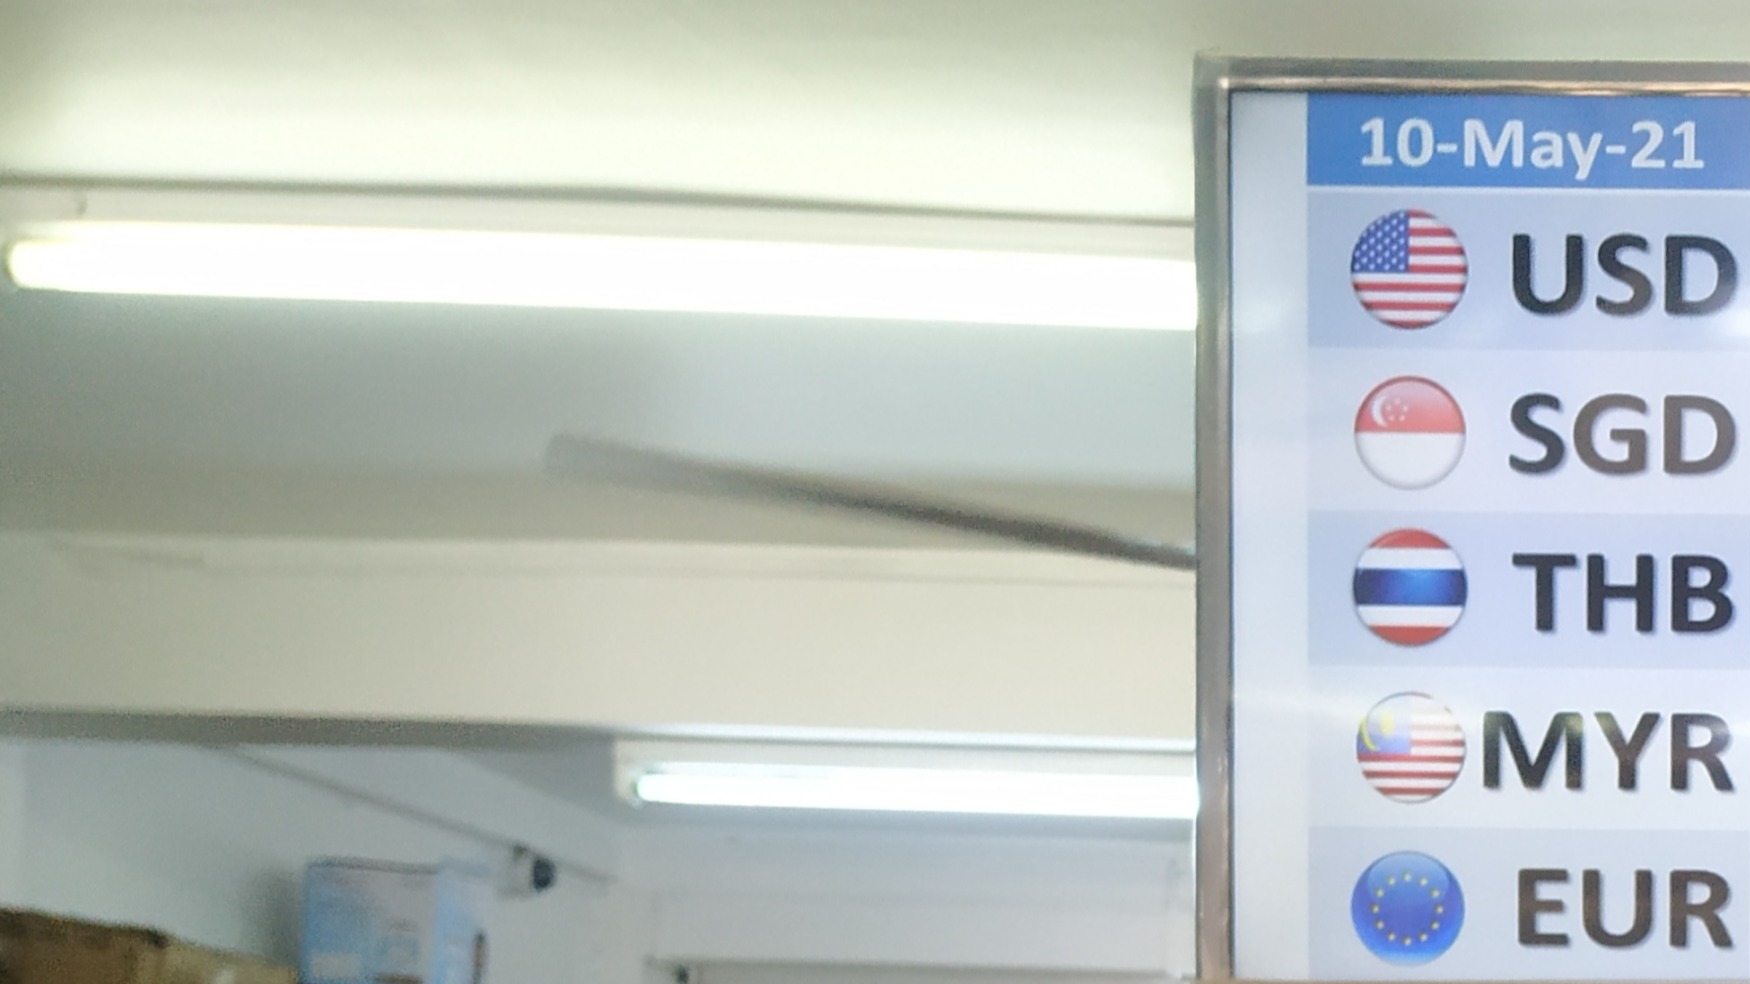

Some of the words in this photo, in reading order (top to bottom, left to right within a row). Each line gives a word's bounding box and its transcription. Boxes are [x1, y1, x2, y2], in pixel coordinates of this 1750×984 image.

[1359, 117, 1705, 180] 10-May-21
[1511, 231, 1740, 317] USD
[1508, 391, 1738, 476] SGD
[1511, 552, 1736, 634] THB
[1482, 710, 1736, 792] MYR
[1515, 867, 1735, 949] EUR
